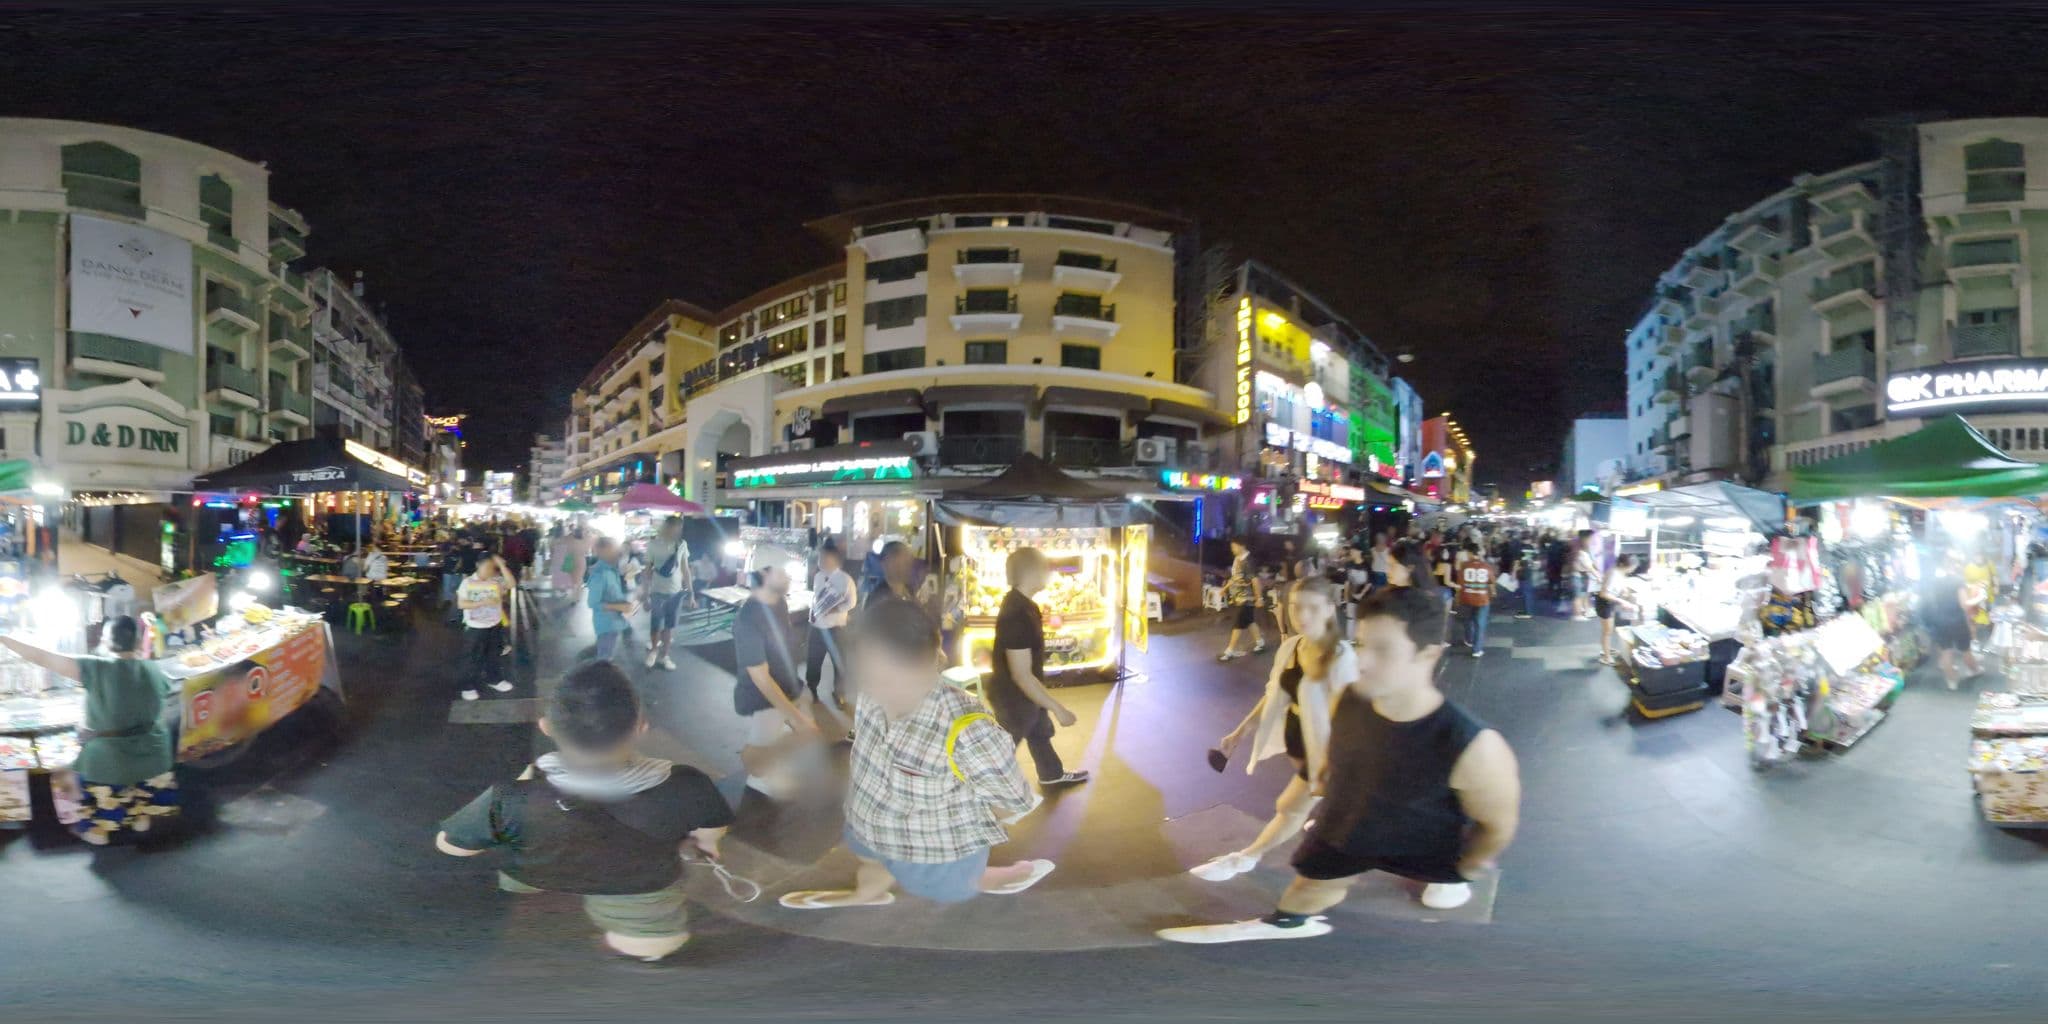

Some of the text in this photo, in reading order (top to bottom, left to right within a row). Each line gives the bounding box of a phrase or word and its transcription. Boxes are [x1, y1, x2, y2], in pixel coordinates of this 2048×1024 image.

[1237, 366, 1251, 424] FOOD
[66, 421, 179, 453] D & D INN
